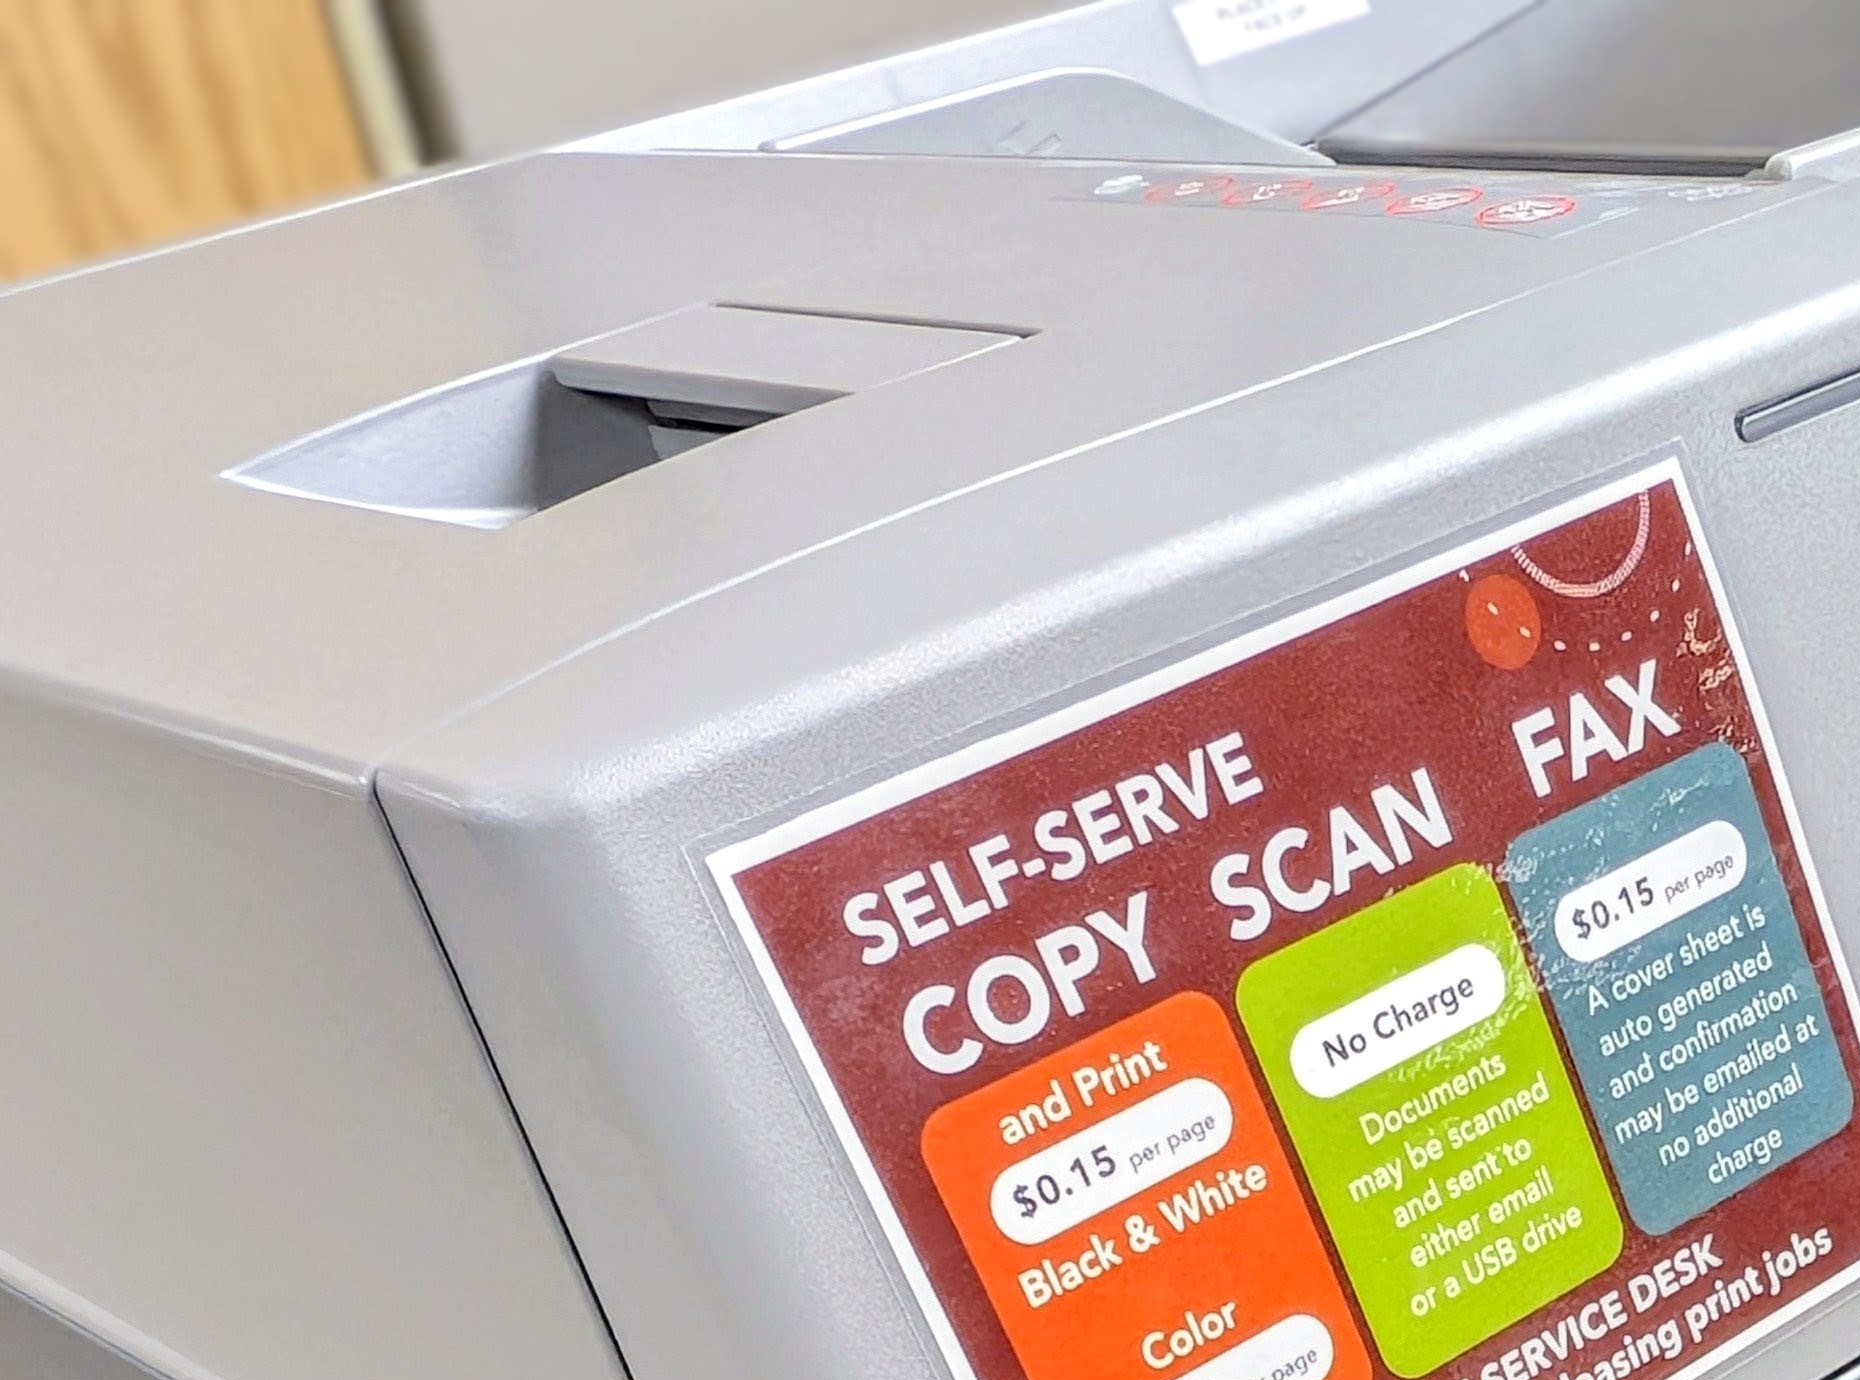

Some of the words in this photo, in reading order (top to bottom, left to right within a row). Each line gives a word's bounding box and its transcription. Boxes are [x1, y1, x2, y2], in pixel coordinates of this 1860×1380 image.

[843, 732, 1266, 966] SELF-SERVE
[903, 891, 1155, 1076] COPY
[1209, 767, 1451, 942] SCAN
[1512, 658, 1680, 798] FAX
[1571, 875, 1655, 940] $0.15
[1664, 877, 1690, 904] per
[1695, 854, 1734, 889] page
[1587, 985, 1608, 1016] A
[1611, 953, 1674, 1002] cover
[1678, 915, 1744, 967] sheet
[1743, 903, 1766, 930] is
[1599, 1014, 1653, 1057] auto
[1657, 941, 1774, 1030] generated
[1321, 1032, 1367, 1067] No
[1373, 975, 1475, 1040] Charge
[1608, 1054, 1655, 1100] and
[1659, 982, 1798, 1072] confirmation
[999, 1080, 1072, 1144] and
[1073, 1041, 1168, 1106] Print
[1358, 1054, 1507, 1145] Documents
[1614, 1102, 1664, 1145] may
[1665, 1079, 1700, 1114] be
[1703, 1026, 1791, 1094] emailed
[1795, 1015, 1820, 1044] at
[1658, 1138, 1691, 1166] no
[1695, 1063, 1803, 1146] additional
[1012, 1146, 1117, 1218] $0.15
[1128, 1144, 1161, 1173] per
[1166, 1114, 1216, 1154] page
[1348, 1158, 1403, 1202] may
[1405, 1133, 1444, 1170] be
[1448, 1071, 1550, 1150] scanned
[1394, 1179, 1444, 1229] and
[1446, 1152, 1502, 1200] sent
[1500, 1137, 1532, 1170] to
[1707, 1126, 1783, 1184] charge
[1017, 1234, 1123, 1309] Black
[1125, 1214, 1160, 1253] &
[1157, 1163, 1268, 1232] White
[1409, 1210, 1481, 1268] either
[1487, 1165, 1553, 1225] email
[1410, 1283, 1437, 1317] or
[1444, 1274, 1461, 1298] a
[1461, 1236, 1518, 1286] USB
[1521, 1205, 1583, 1254] drive
[1627, 1233, 1724, 1315] DESK
[1683, 1268, 1762, 1342] print
[1761, 1226, 1833, 1296] jobs
[1141, 1301, 1239, 1370] Color
